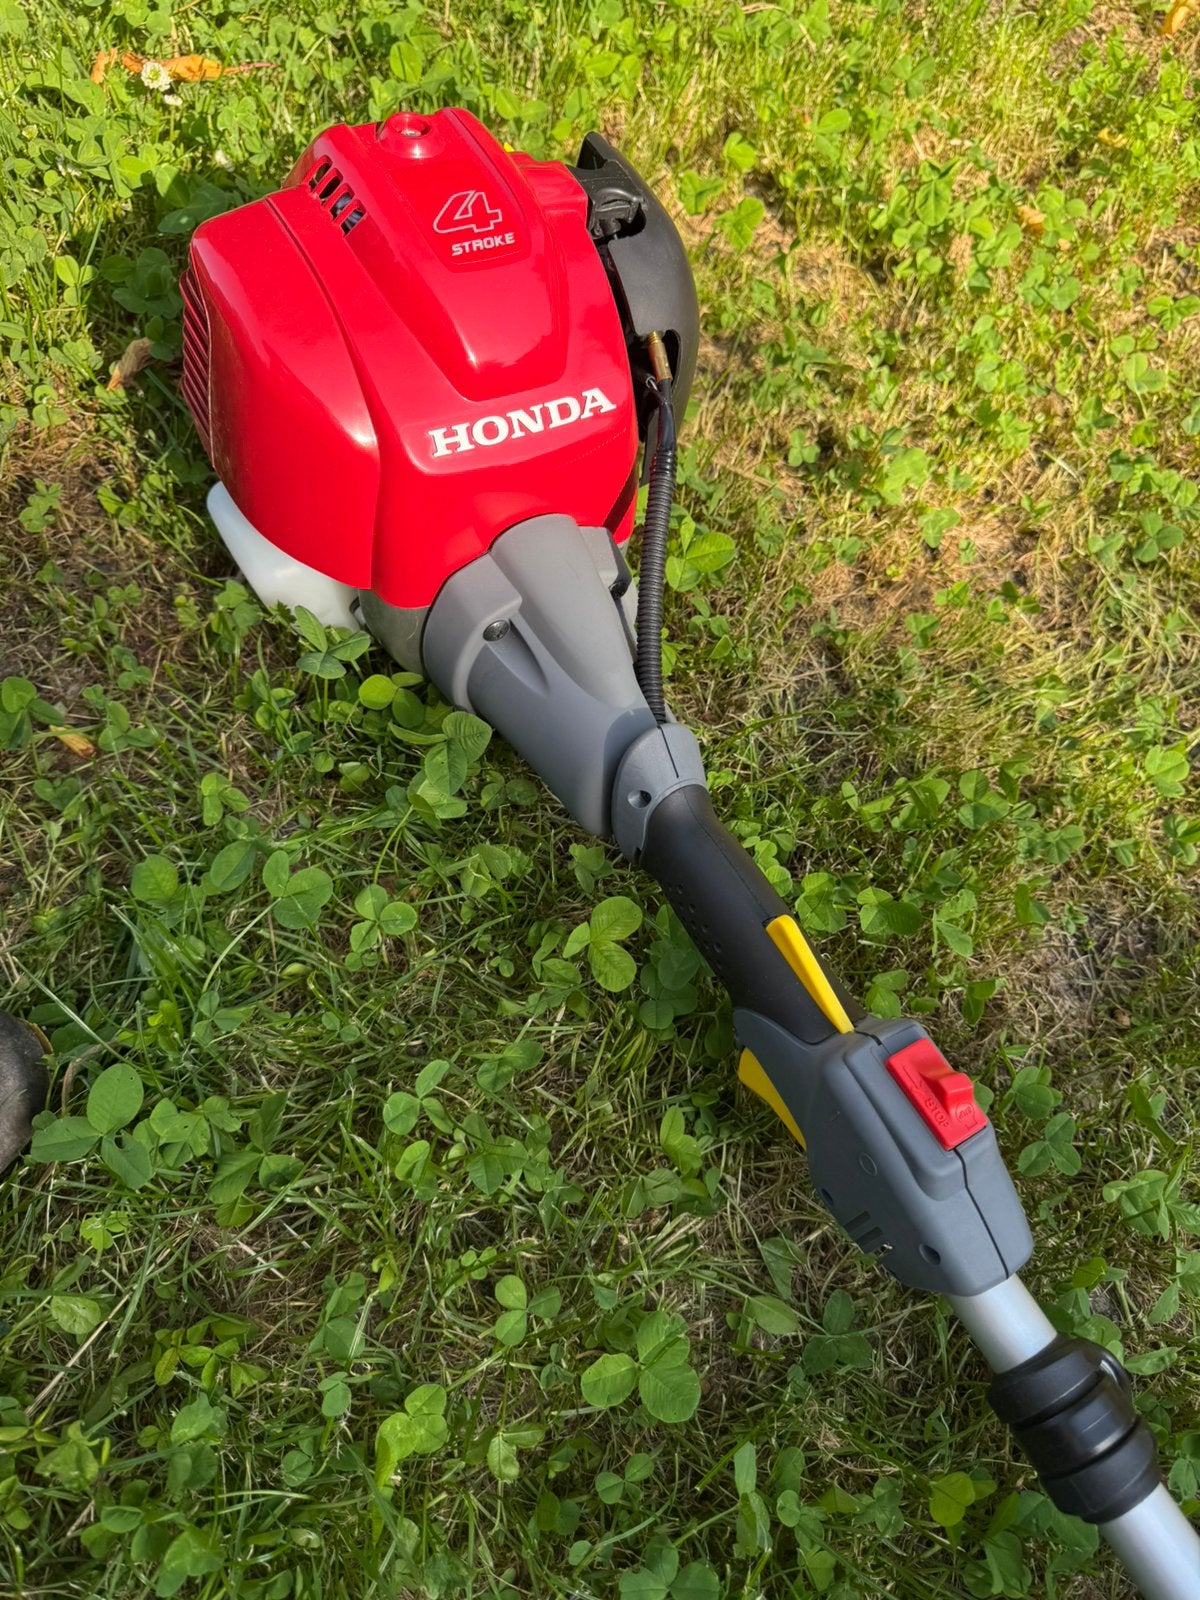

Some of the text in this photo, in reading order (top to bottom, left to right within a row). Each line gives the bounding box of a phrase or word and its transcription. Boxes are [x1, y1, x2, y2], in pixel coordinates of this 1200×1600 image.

[433, 190, 503, 234] 4
[451, 232, 516, 257] STROKE
[428, 387, 617, 458] HONDA
